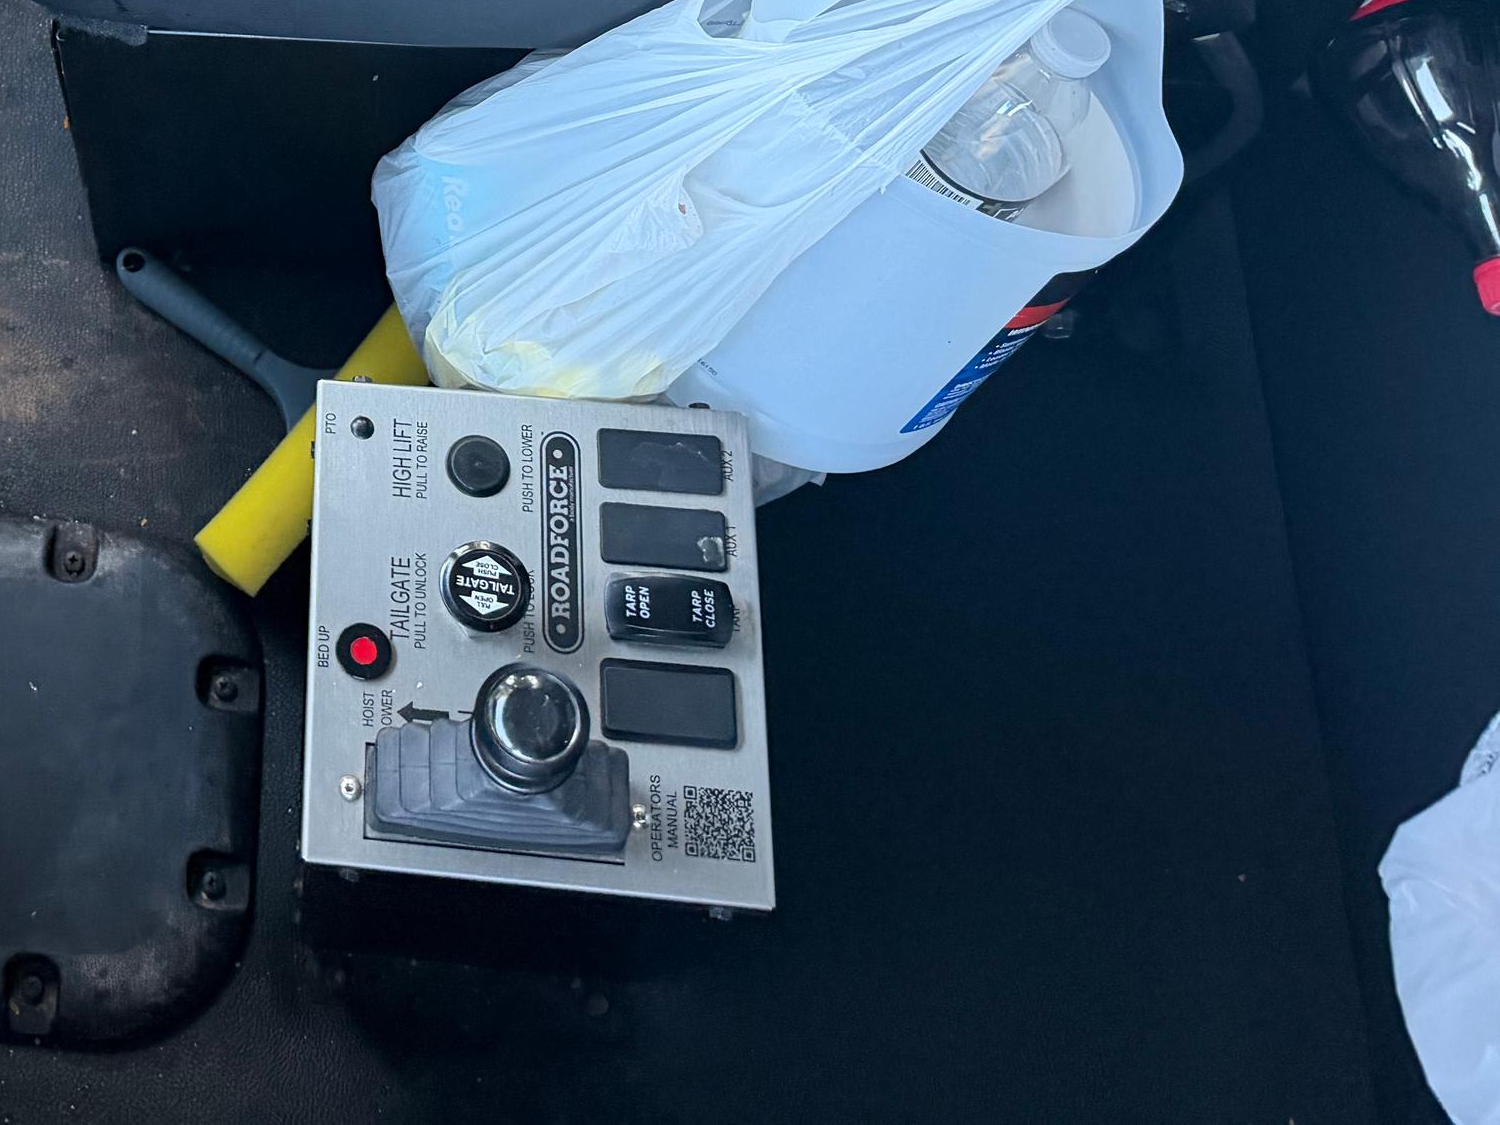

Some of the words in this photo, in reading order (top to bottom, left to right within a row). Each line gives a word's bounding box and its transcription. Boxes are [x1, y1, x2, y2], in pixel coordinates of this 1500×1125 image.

[324, 412, 337, 434] PTO
[393, 418, 412, 457] LIFT
[416, 421, 429, 455] RAISE
[522, 424, 533, 463] LOWER
[416, 455, 428, 473] TO
[722, 450, 733, 460] 2
[393, 460, 412, 498] HIGH
[522, 466, 534, 483] TO
[722, 460, 734, 482] AUX
[416, 475, 428, 500] PULL
[522, 485, 534, 513] PUSH
[549, 463, 571, 620] ROADFORCE
[726, 535, 738, 557] AUX
[414, 552, 427, 602] UNLOCK
[476, 562, 499, 570] CLOSE
[477, 568, 497, 577] PUSH
[391, 557, 410, 641] TAILGATE
[456, 575, 515, 595] TAILGATE
[475, 595, 494, 603] OPEN
[414, 603, 427, 621] TO
[477, 601, 491, 609] PULL
[626, 585, 637, 618] TARP
[639, 586, 650, 619] OPEN
[692, 590, 703, 623] TARP
[705, 589, 716, 629] CLOSE
[318, 625, 330, 643] UP
[414, 624, 427, 649] PULL
[524, 622, 535, 653] PUSH
[318, 644, 329, 667] BED
[363, 691, 374, 727] HOIST
[381, 689, 393, 725] OWER
[650, 774, 663, 862] OPERATORS
[666, 790, 678, 848] MANUAL
